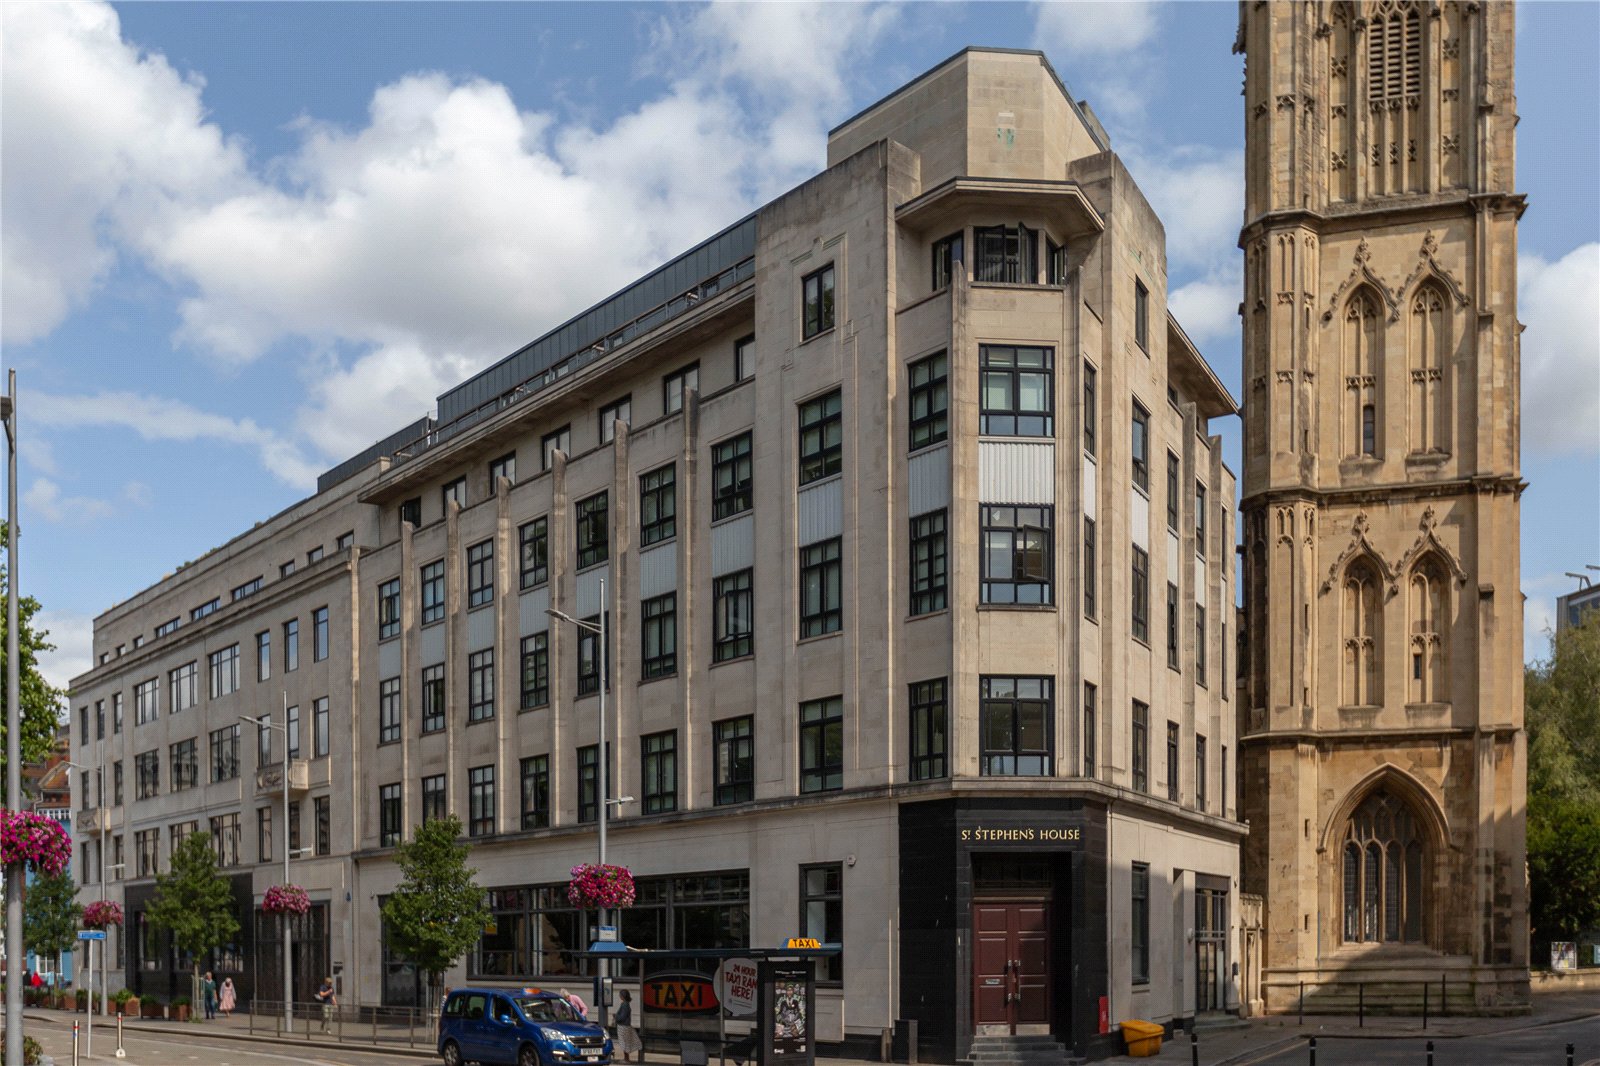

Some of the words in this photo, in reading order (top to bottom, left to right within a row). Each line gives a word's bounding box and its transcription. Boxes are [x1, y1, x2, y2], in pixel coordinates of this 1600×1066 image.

[975, 828, 1034, 840] STEPHEN'S
[1040, 829, 1080, 840] HOUSE
[793, 939, 815, 949] TAXI
[733, 963, 740, 973] 24
[741, 965, 756, 977] HOUR
[725, 971, 741, 986] TAXI
[742, 975, 758, 990] RAN
[652, 985, 703, 1007] TAXI
[731, 985, 754, 1000] HERE!
